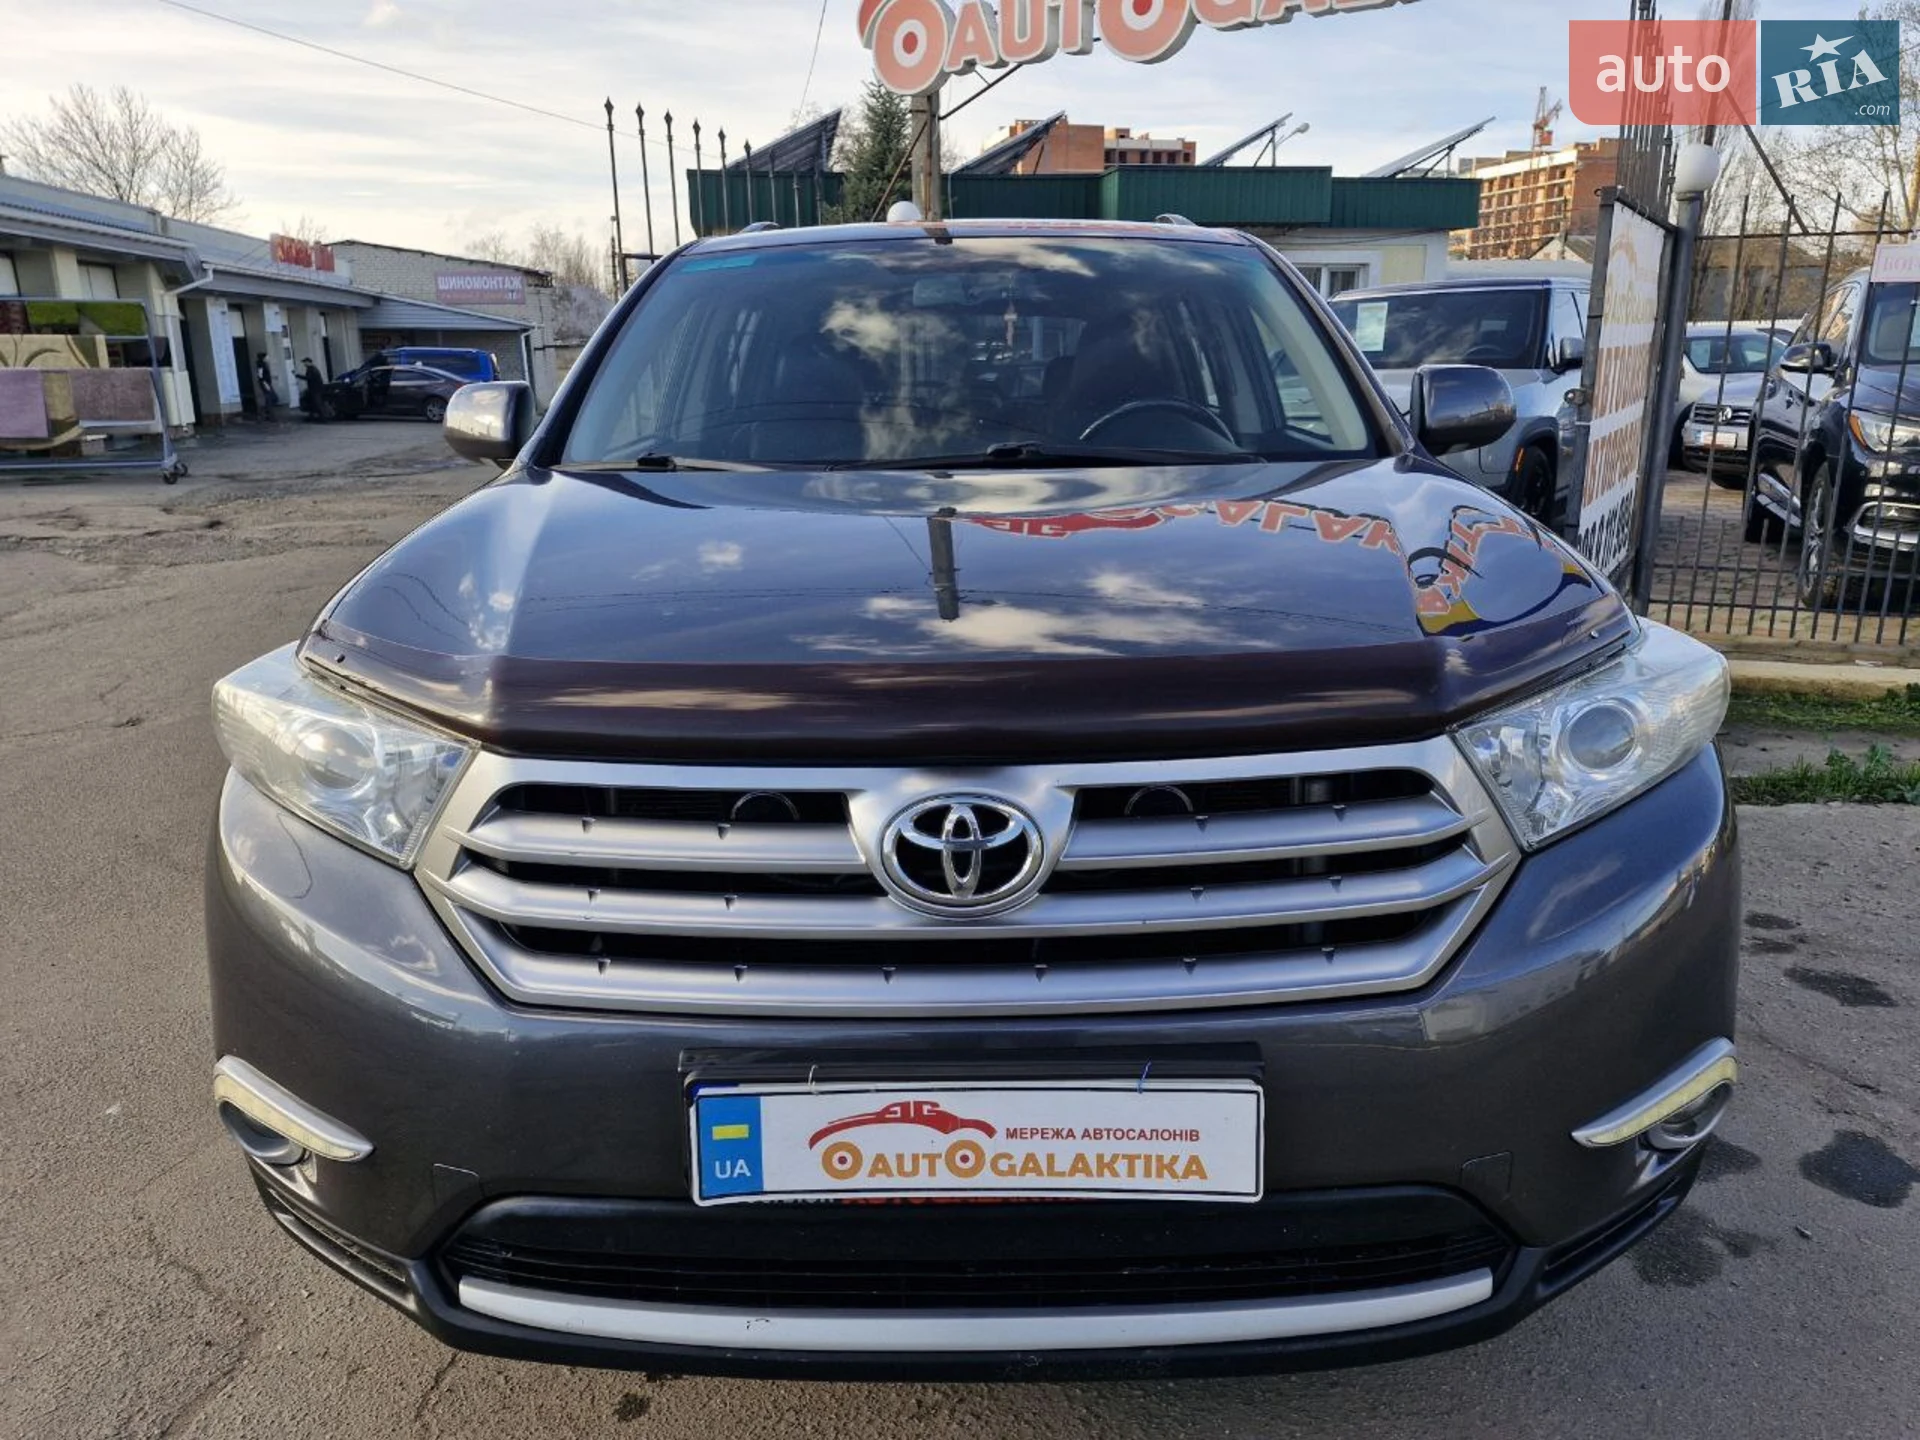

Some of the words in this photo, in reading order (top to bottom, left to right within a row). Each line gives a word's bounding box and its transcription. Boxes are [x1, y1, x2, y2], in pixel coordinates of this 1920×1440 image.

[437, 275, 523, 290] ШИНОМОНТАЖ
[1005, 1127, 1076, 1141] МЕРЕЖА
[1080, 1127, 1201, 1143] АВТОСАЛОНІВ
[714, 1158, 752, 1179] UA
